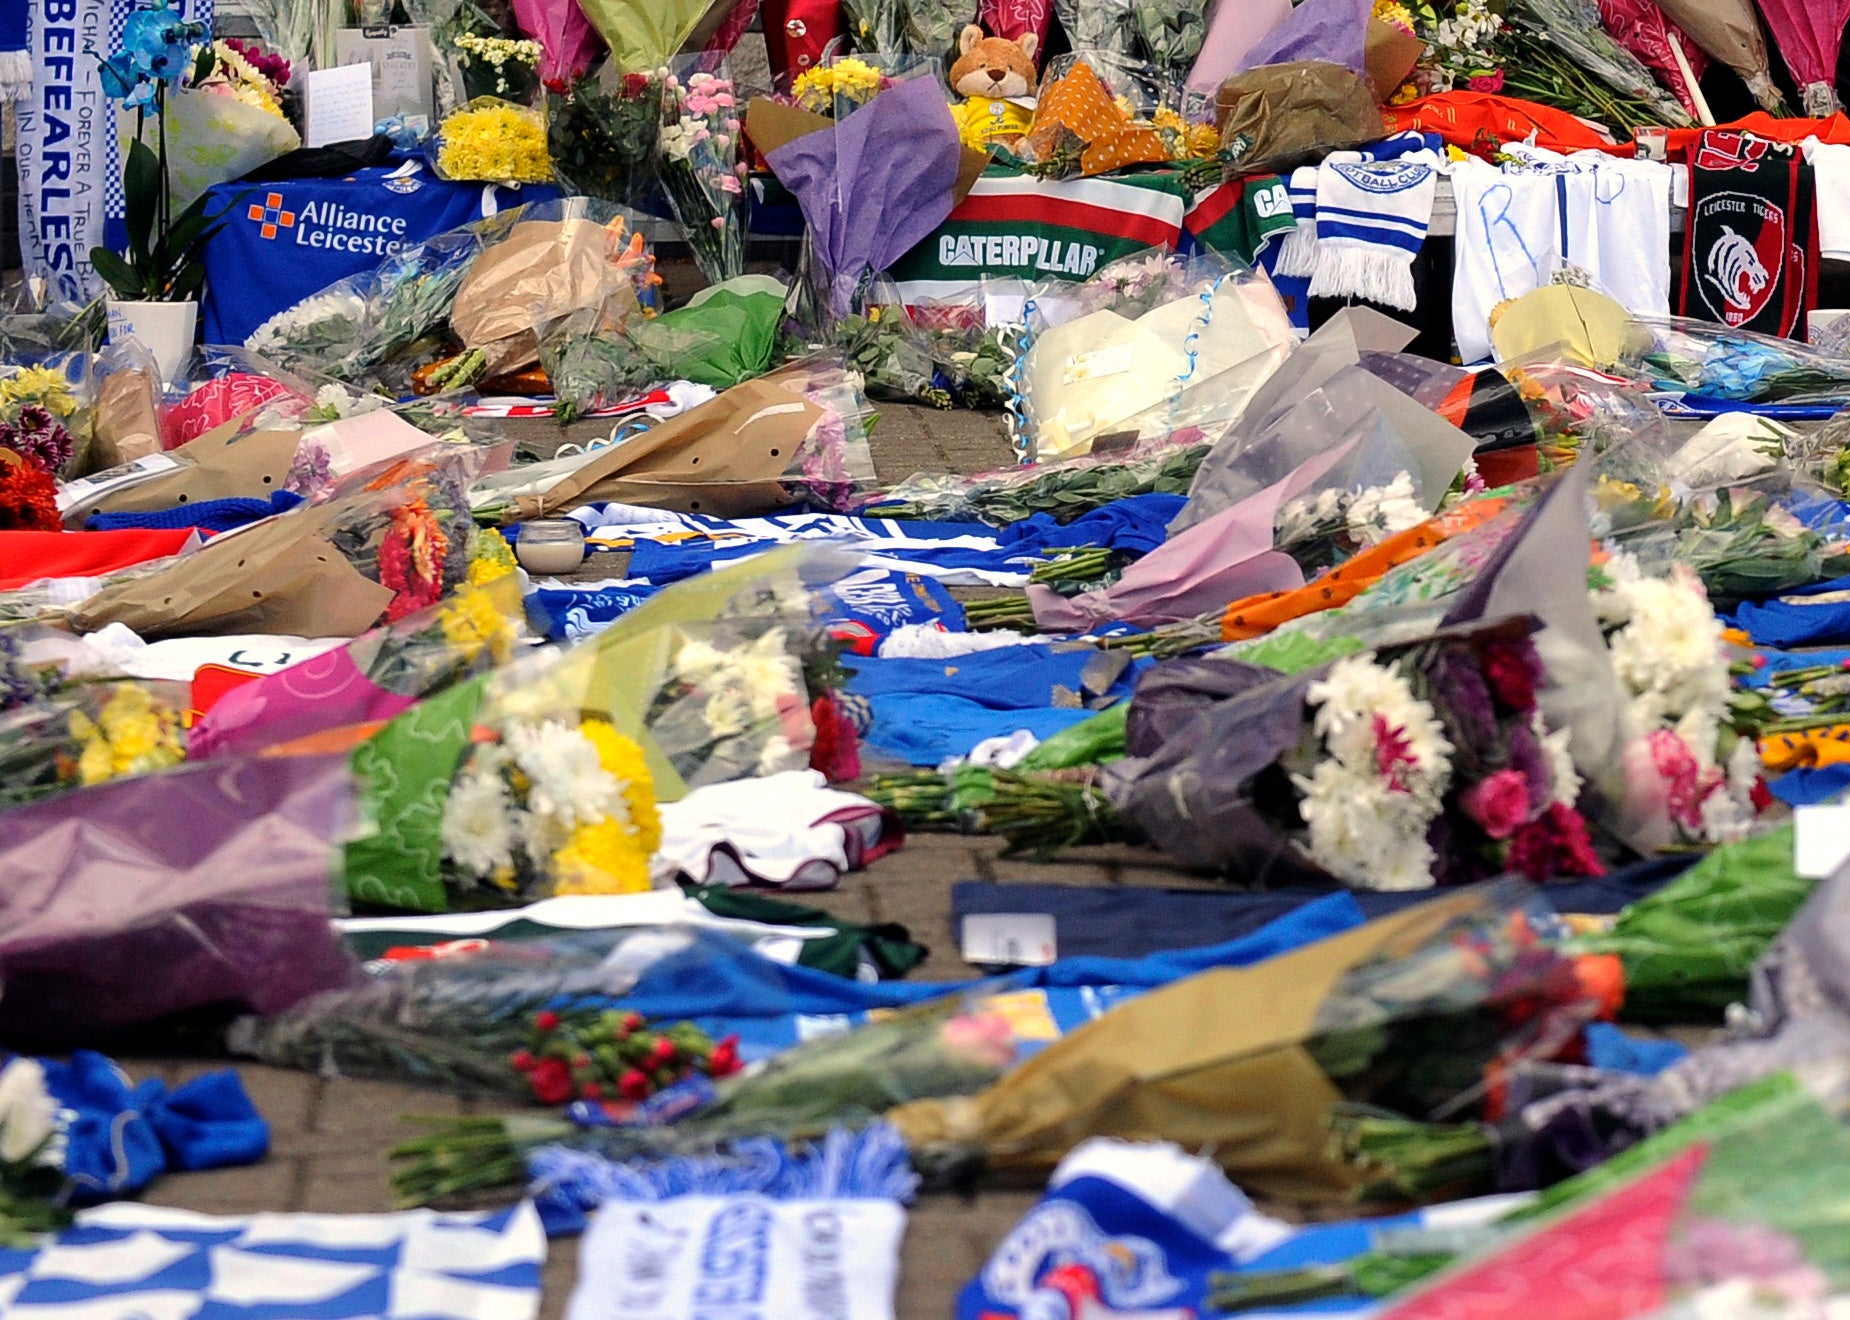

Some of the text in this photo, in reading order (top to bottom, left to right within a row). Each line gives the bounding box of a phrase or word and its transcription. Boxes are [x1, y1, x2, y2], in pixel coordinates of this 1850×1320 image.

[18, 110, 37, 133] IN
[75, 90, 96, 174] FOREVER
[74, 181, 92, 196] A
[73, 202, 91, 252] TRUE
[299, 200, 407, 236] Alliance
[1704, 199, 1779, 225] LEICESTER TIGERS
